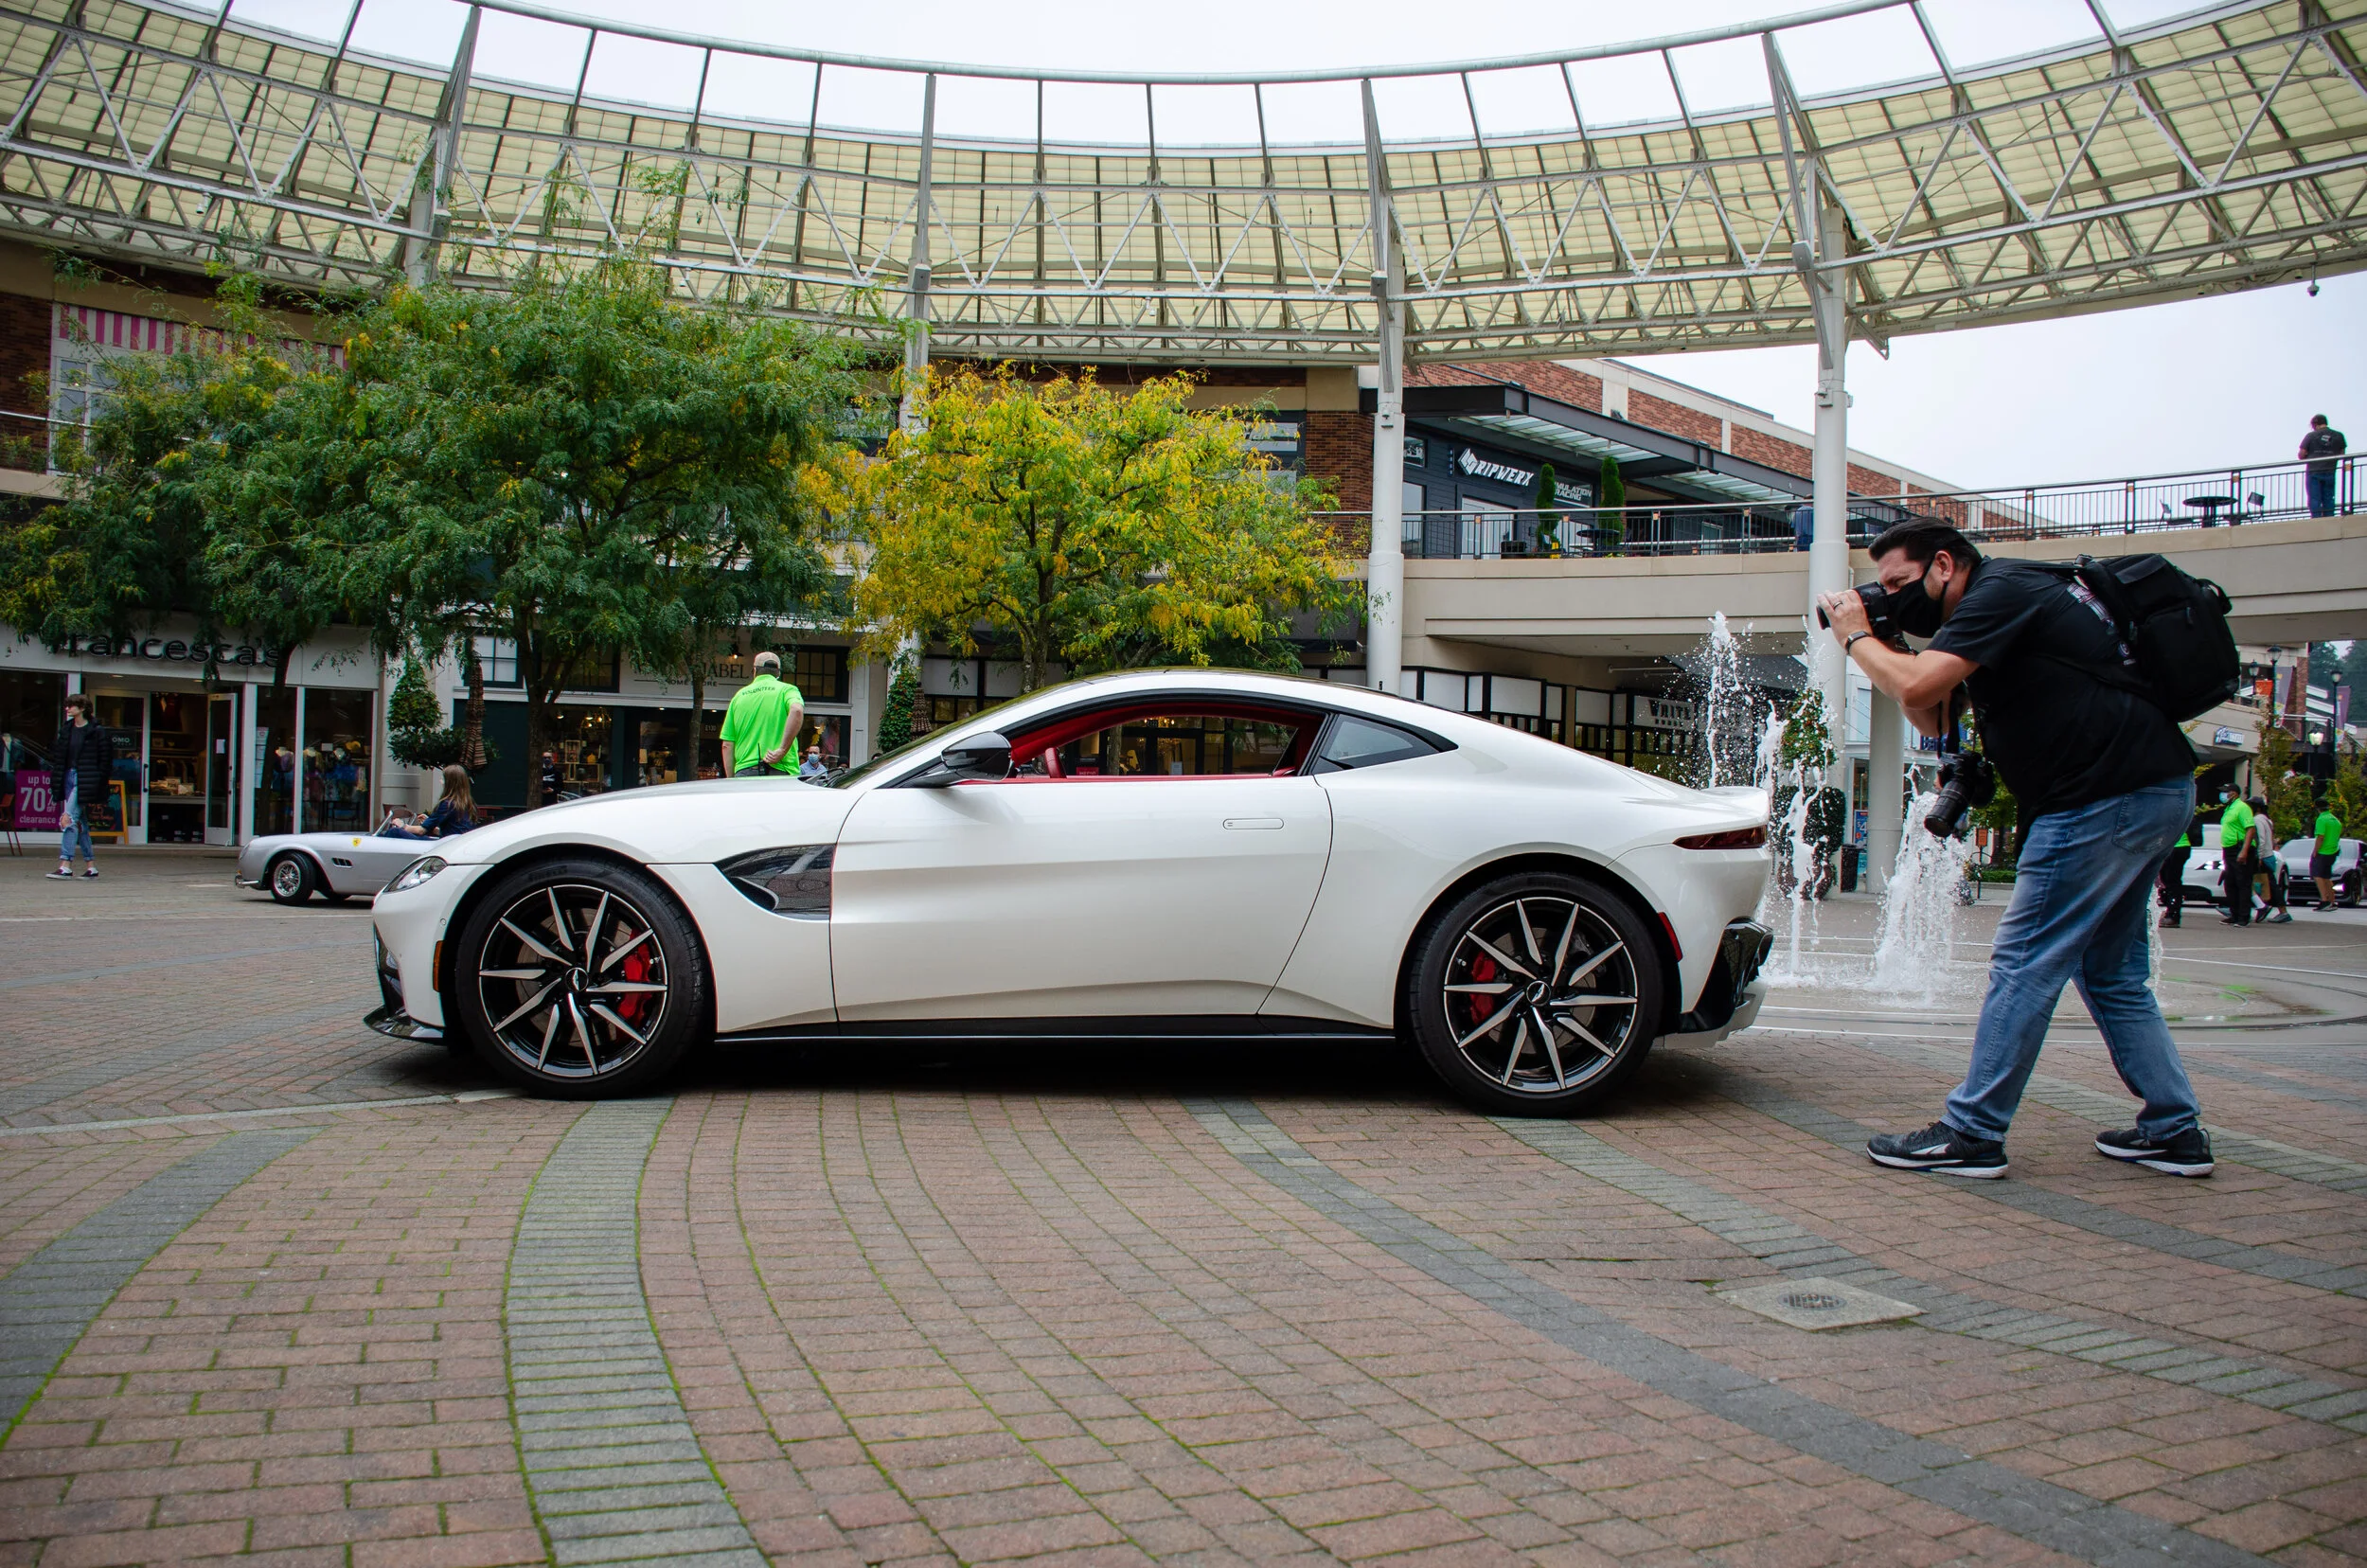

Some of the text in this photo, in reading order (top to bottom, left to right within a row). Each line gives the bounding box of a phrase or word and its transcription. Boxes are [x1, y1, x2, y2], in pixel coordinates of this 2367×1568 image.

[1554, 489, 1581, 502] RACING
[59, 629, 279, 668] rancesca's
[741, 686, 775, 696] VOLUNTEER
[27, 775, 51, 785] up to
[19, 814, 56, 824] clearance
